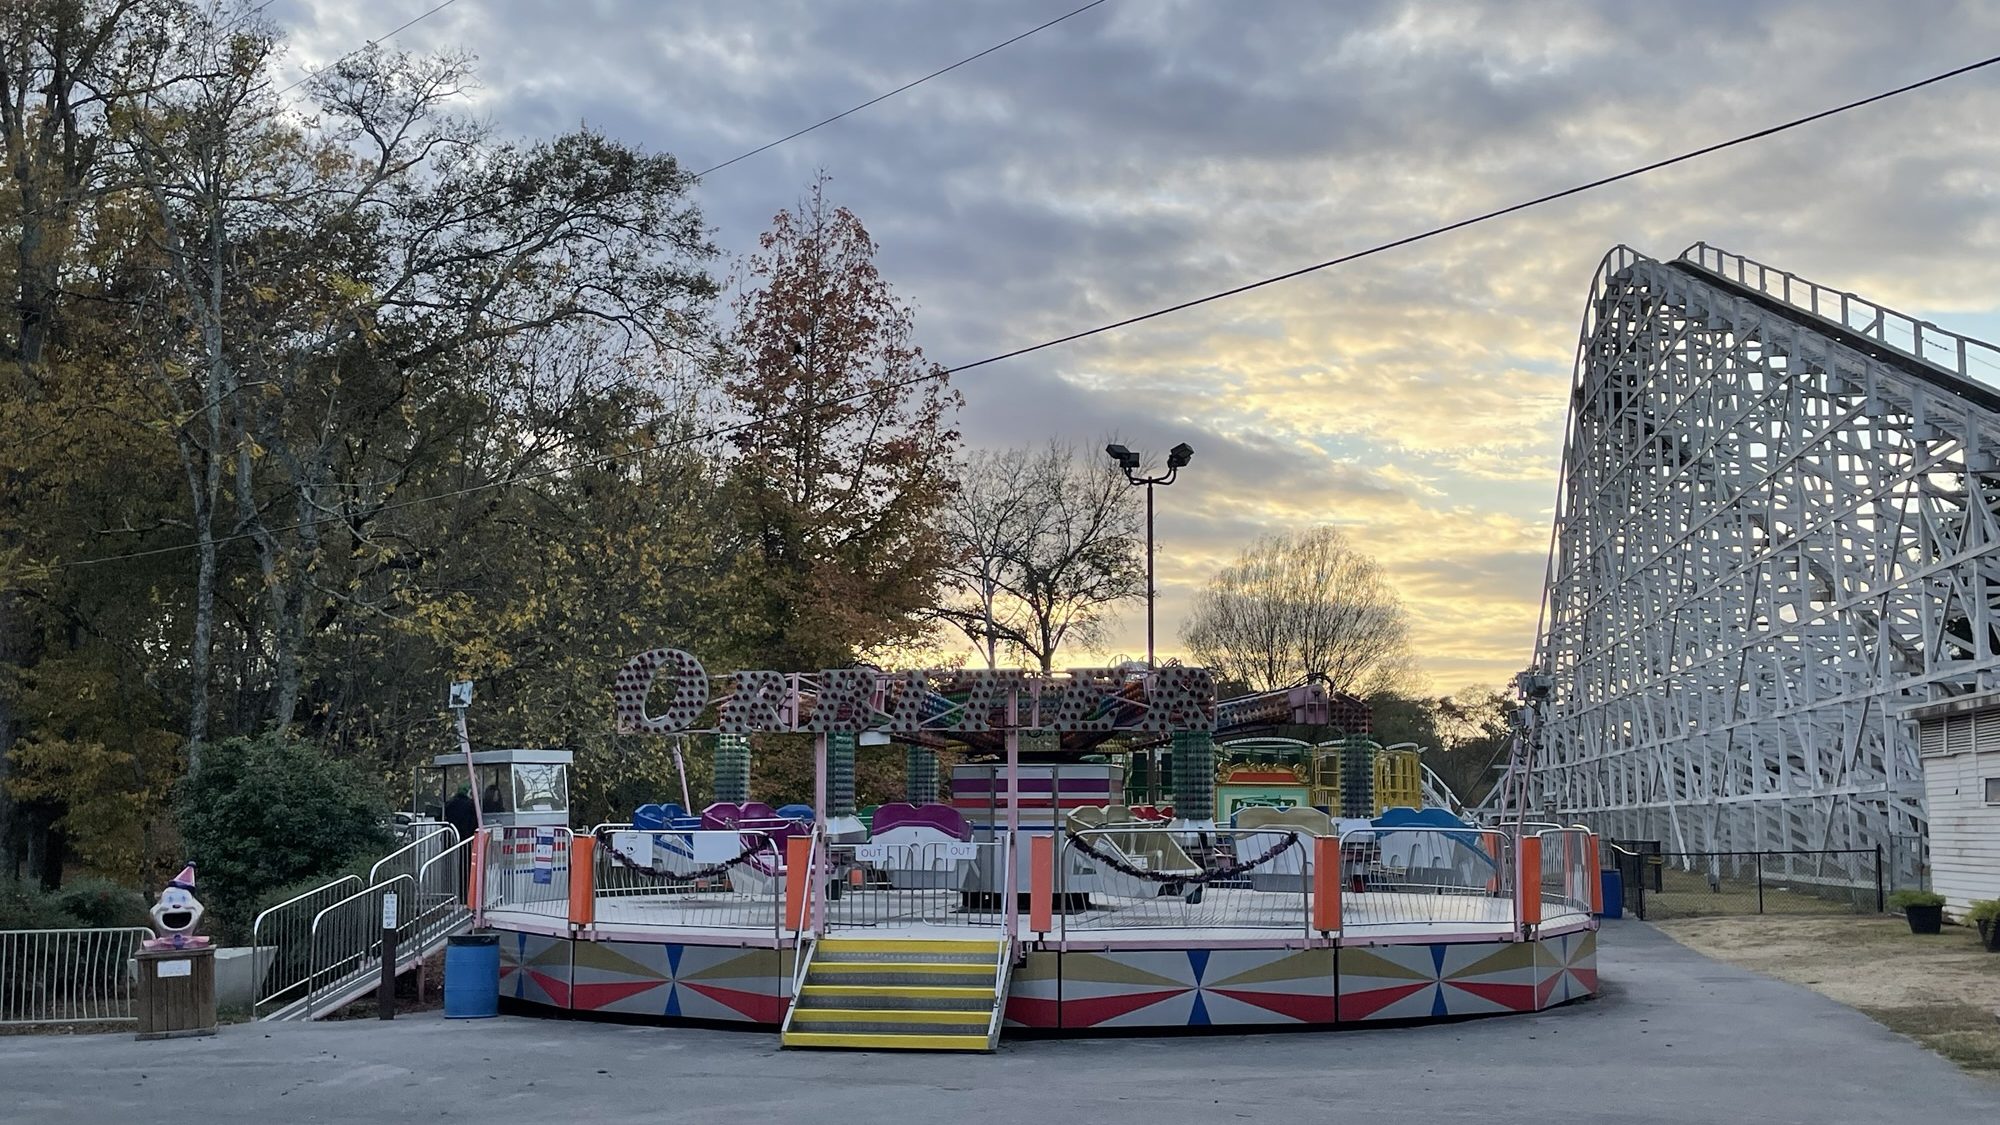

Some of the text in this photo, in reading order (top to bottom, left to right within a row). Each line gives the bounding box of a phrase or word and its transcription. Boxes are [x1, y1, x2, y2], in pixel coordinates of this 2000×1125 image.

[615, 648, 1214, 733] ORBITER
[861, 848, 882, 858] OUT
[951, 847, 971, 856] OUT
